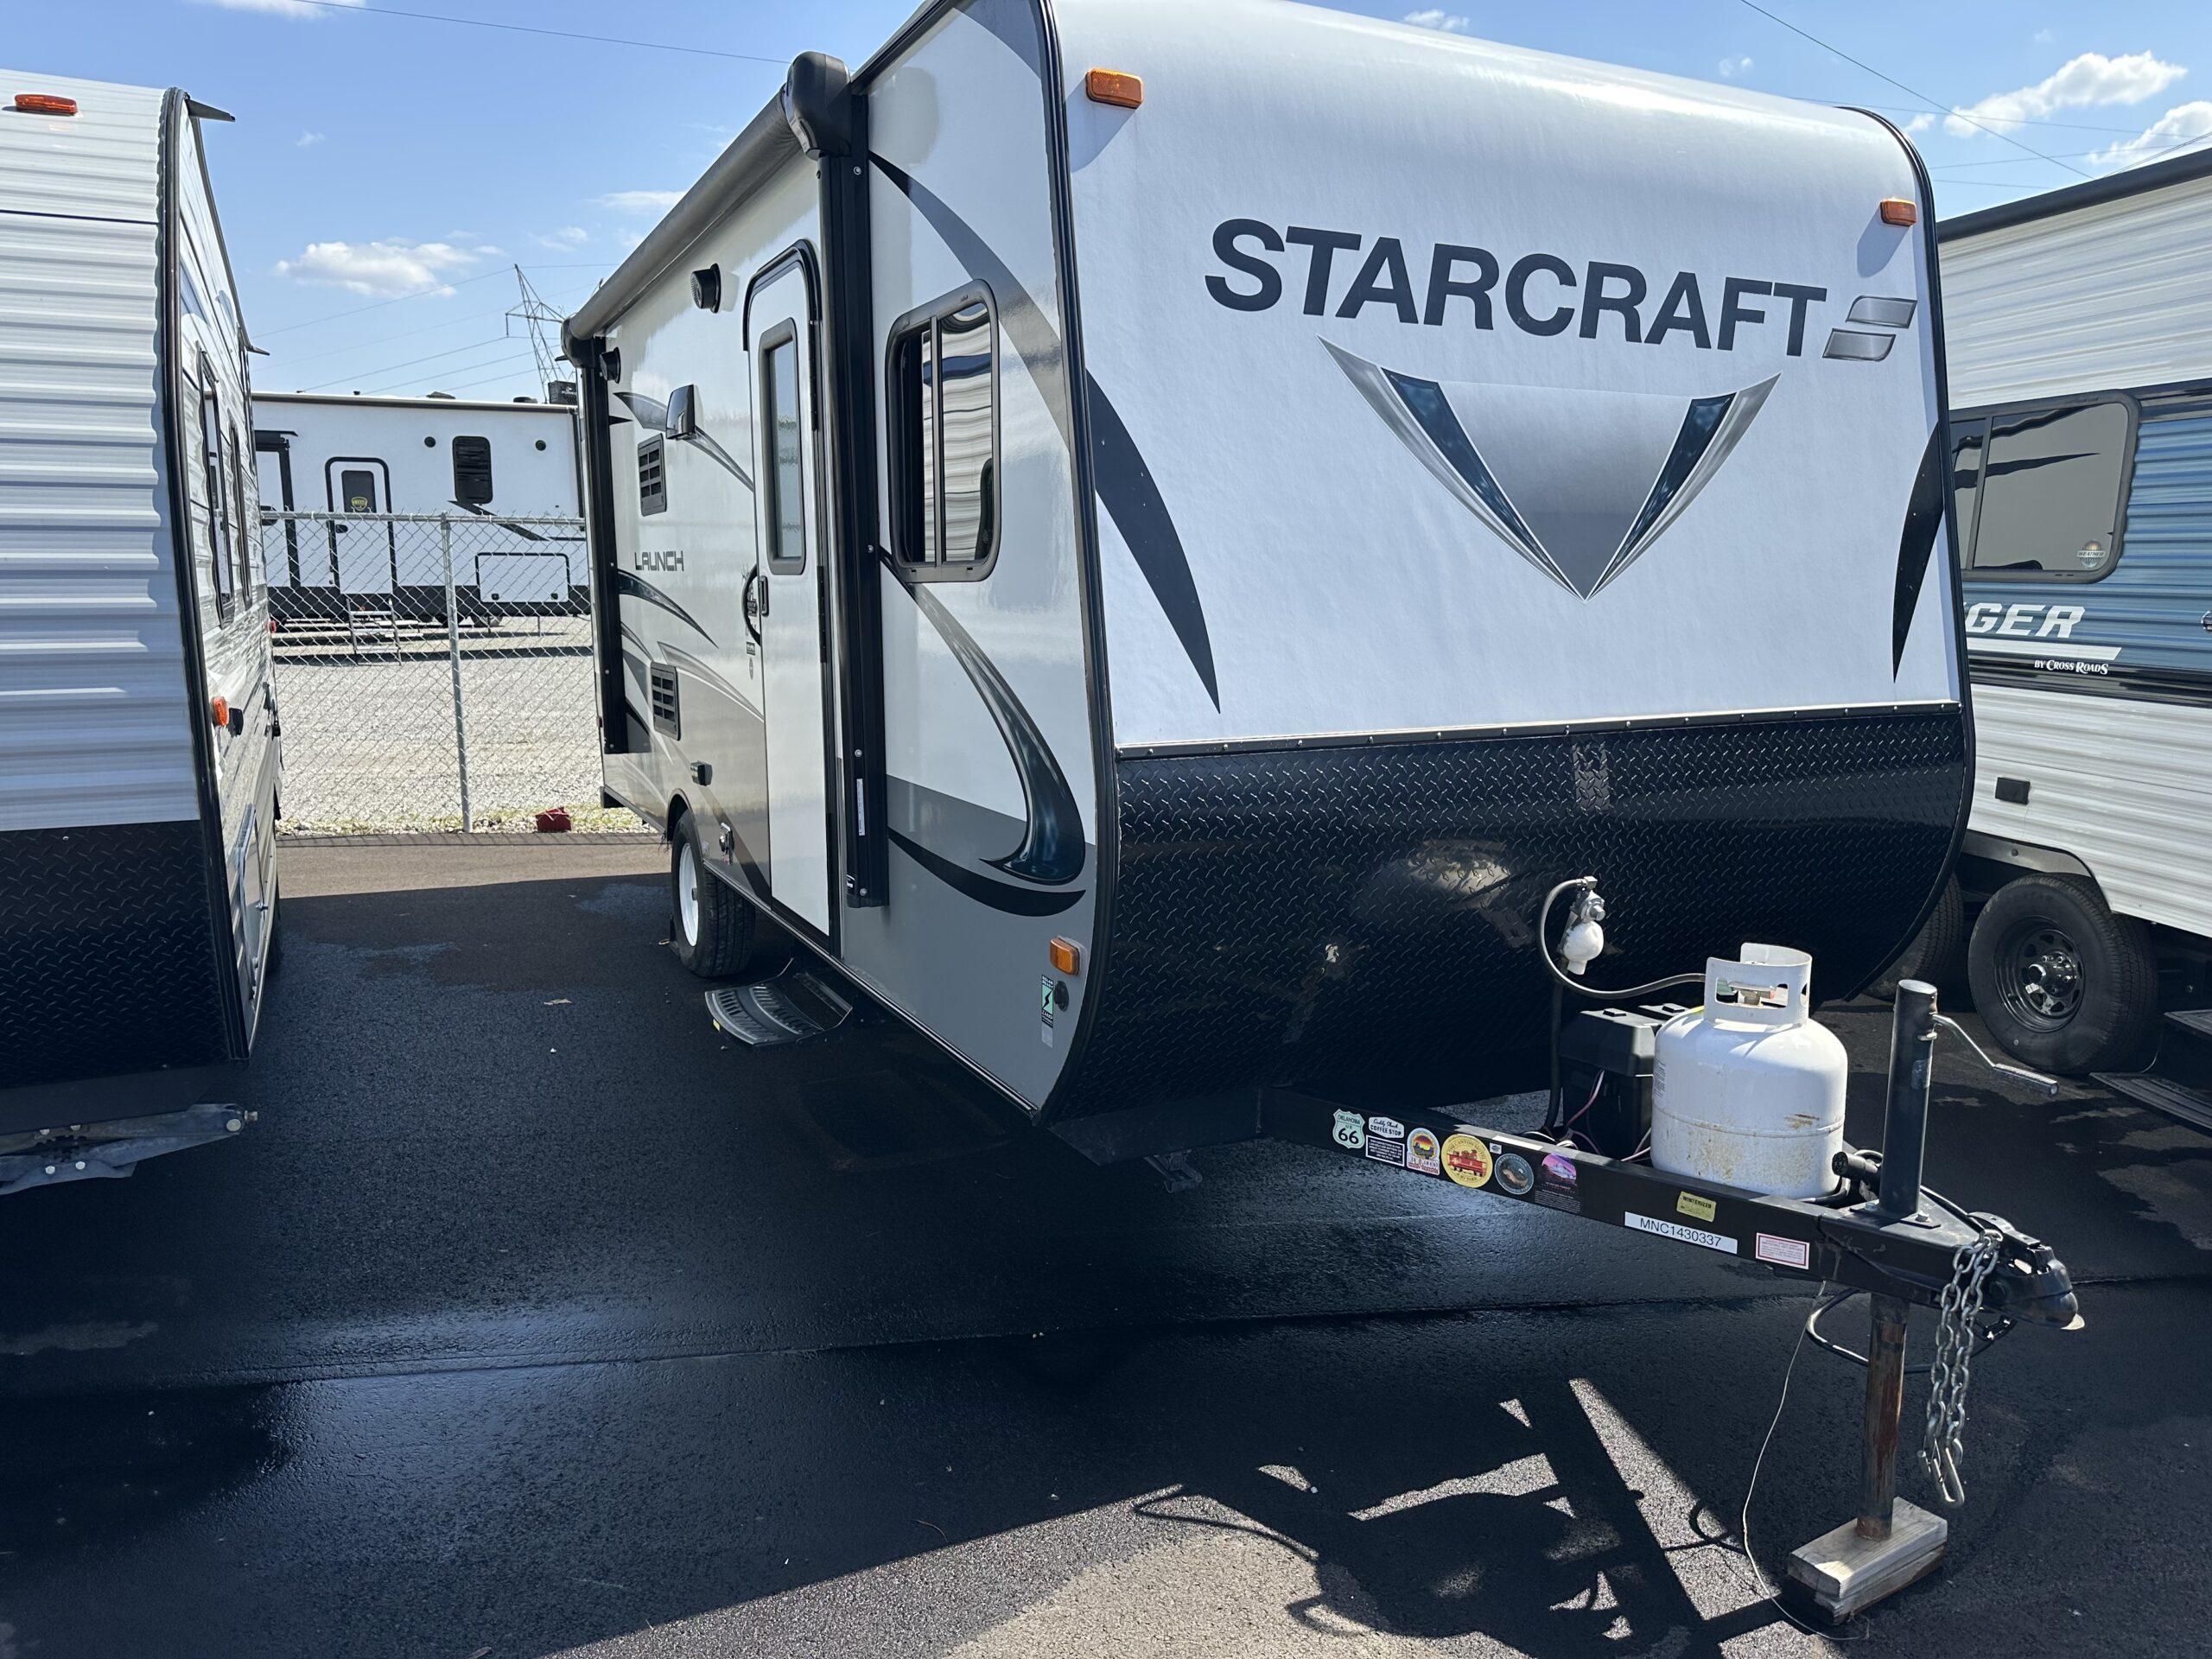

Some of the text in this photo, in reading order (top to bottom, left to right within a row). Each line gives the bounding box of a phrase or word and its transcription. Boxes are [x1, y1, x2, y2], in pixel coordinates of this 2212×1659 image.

[1205, 217, 1827, 358] STARCRAFT
[634, 550, 684, 572] LAUNCH
[1963, 602, 2086, 639] GER
[2034, 660, 2046, 669] BY
[1338, 1114, 1361, 1125] OKLAHOMA
[1338, 1128, 1359, 1144] 66
[1370, 1125, 1388, 1134] COFFEE
[1682, 1195, 1712, 1209] WINTERIZED
[1640, 1217, 1722, 1248] MNC1430337
